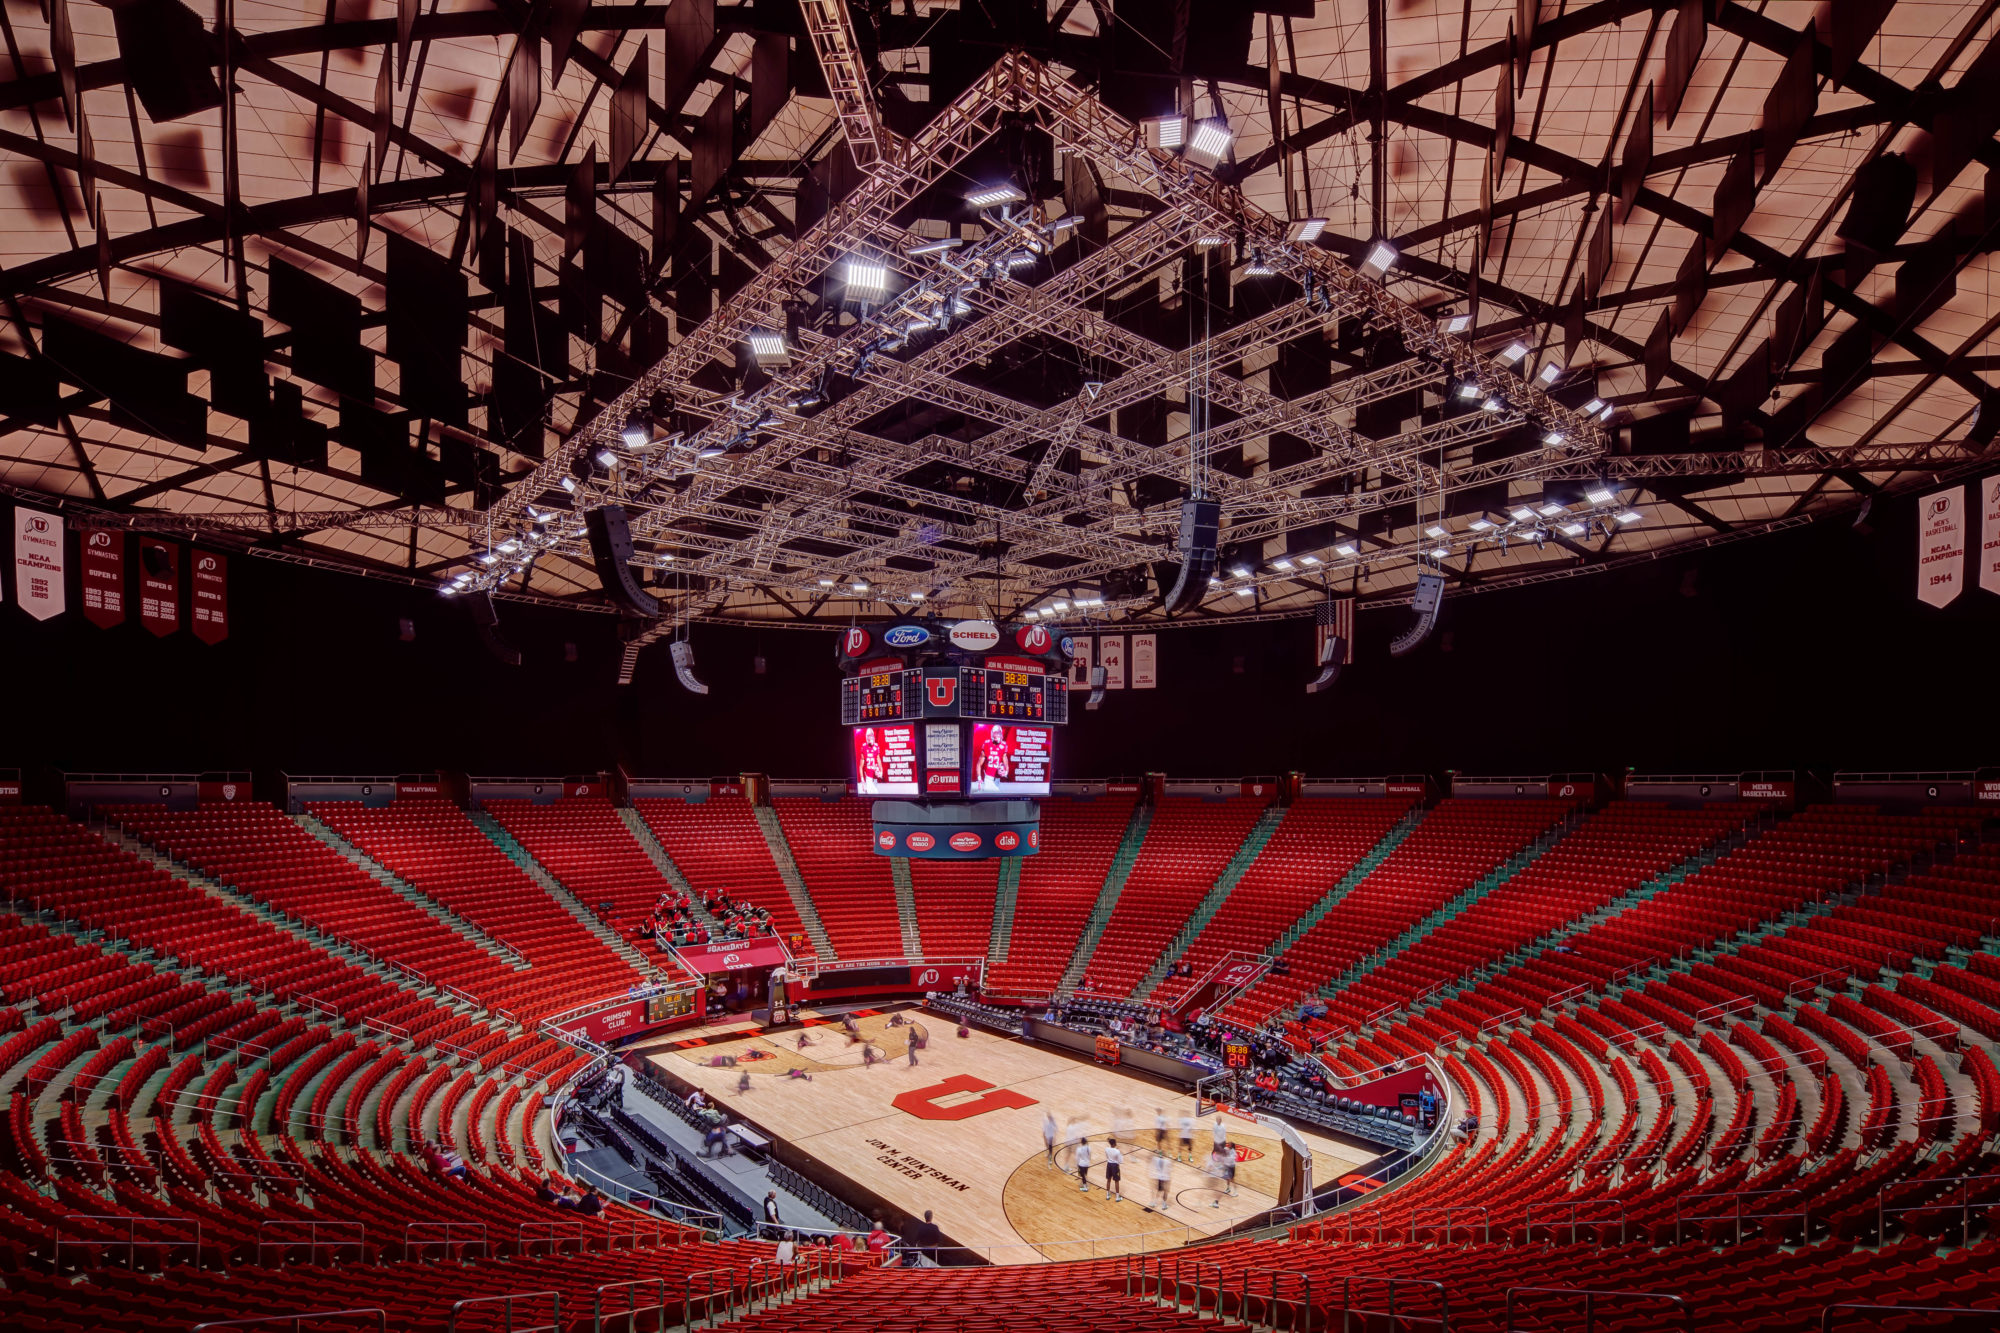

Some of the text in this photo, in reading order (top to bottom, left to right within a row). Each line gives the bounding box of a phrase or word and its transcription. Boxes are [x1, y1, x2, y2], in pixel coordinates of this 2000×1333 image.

[1933, 518, 1949, 528] MEN'S
[1925, 523, 1958, 537] BASKETBALL
[22, 535, 57, 547] GYMNASTICS
[87, 548, 118, 560] GYMNASTICS
[1931, 544, 1951, 554] NCAA
[28, 553, 51, 563] NCAA
[1921, 549, 1963, 564] CHAMPIONS
[17, 558, 61, 572] CHAMPIONS
[88, 569, 111, 579] SUPER
[196, 572, 223, 583] GYMNASTICS
[1929, 573, 1952, 586] 1944
[31, 577, 48, 586] 1992
[146, 580, 167, 589] SUPER
[892, 628, 920, 644] Ford
[952, 631, 997, 640] SCHEELS
[1103, 640, 1121, 649] UTAH
[1135, 639, 1153, 648] UTAH
[1073, 657, 1087, 668] 33
[1105, 656, 1118, 667] 44
[1027, 665, 1044, 673] CENTER
[925, 677, 957, 707] U
[988, 755, 999, 768] 23
[940, 776, 959, 784] UTAH
[1928, 787, 1937, 797] Q
[999, 836, 1015, 845] dish
[601, 1009, 632, 1024] CRIMSON
[608, 1018, 626, 1030] CLUB
[1229, 1053, 1246, 1066] 24
[891, 1074, 1040, 1121] U
[864, 1138, 971, 1192] JON M. HUNTSMAN
[876, 1155, 923, 1180] CENTER
